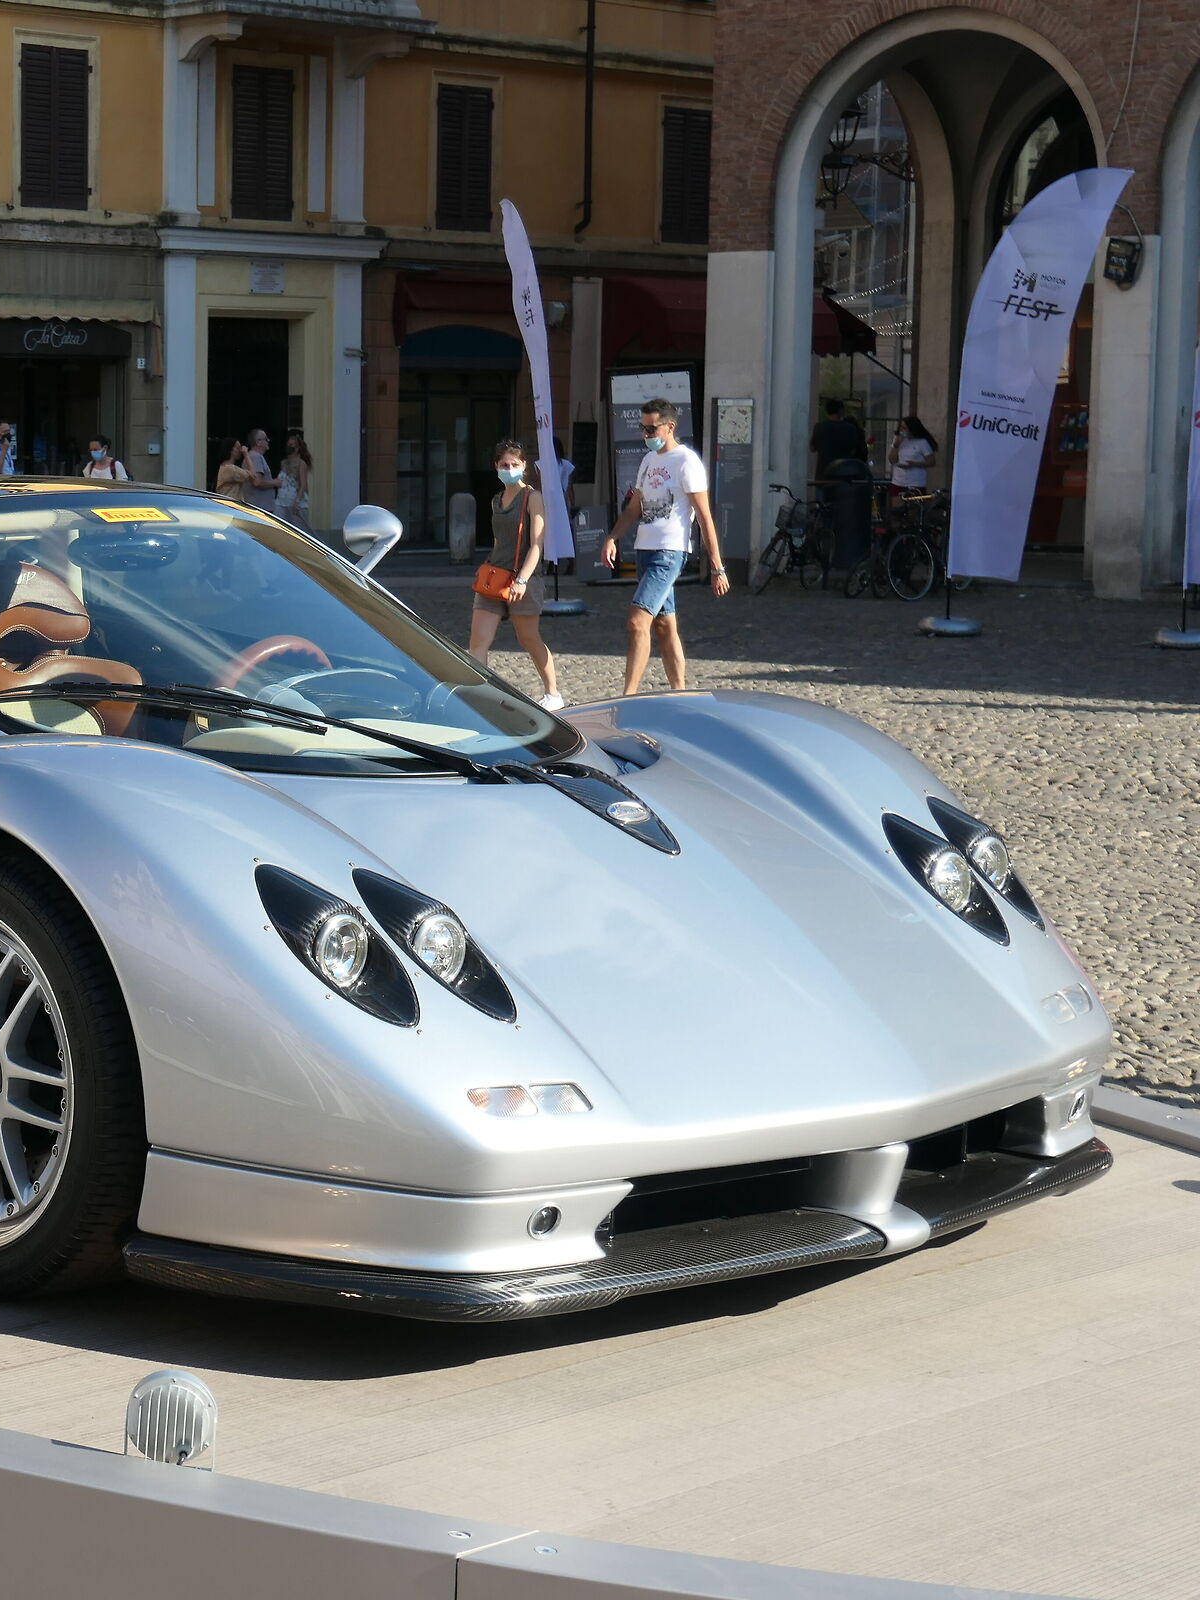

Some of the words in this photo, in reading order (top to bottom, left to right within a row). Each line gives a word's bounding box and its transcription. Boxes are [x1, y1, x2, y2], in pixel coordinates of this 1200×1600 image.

[1002, 294, 1059, 322] FEST
[981, 390, 996, 399] MAIN
[972, 414, 1040, 441] UniCredit
[101, 510, 162, 519] PIRELLI
